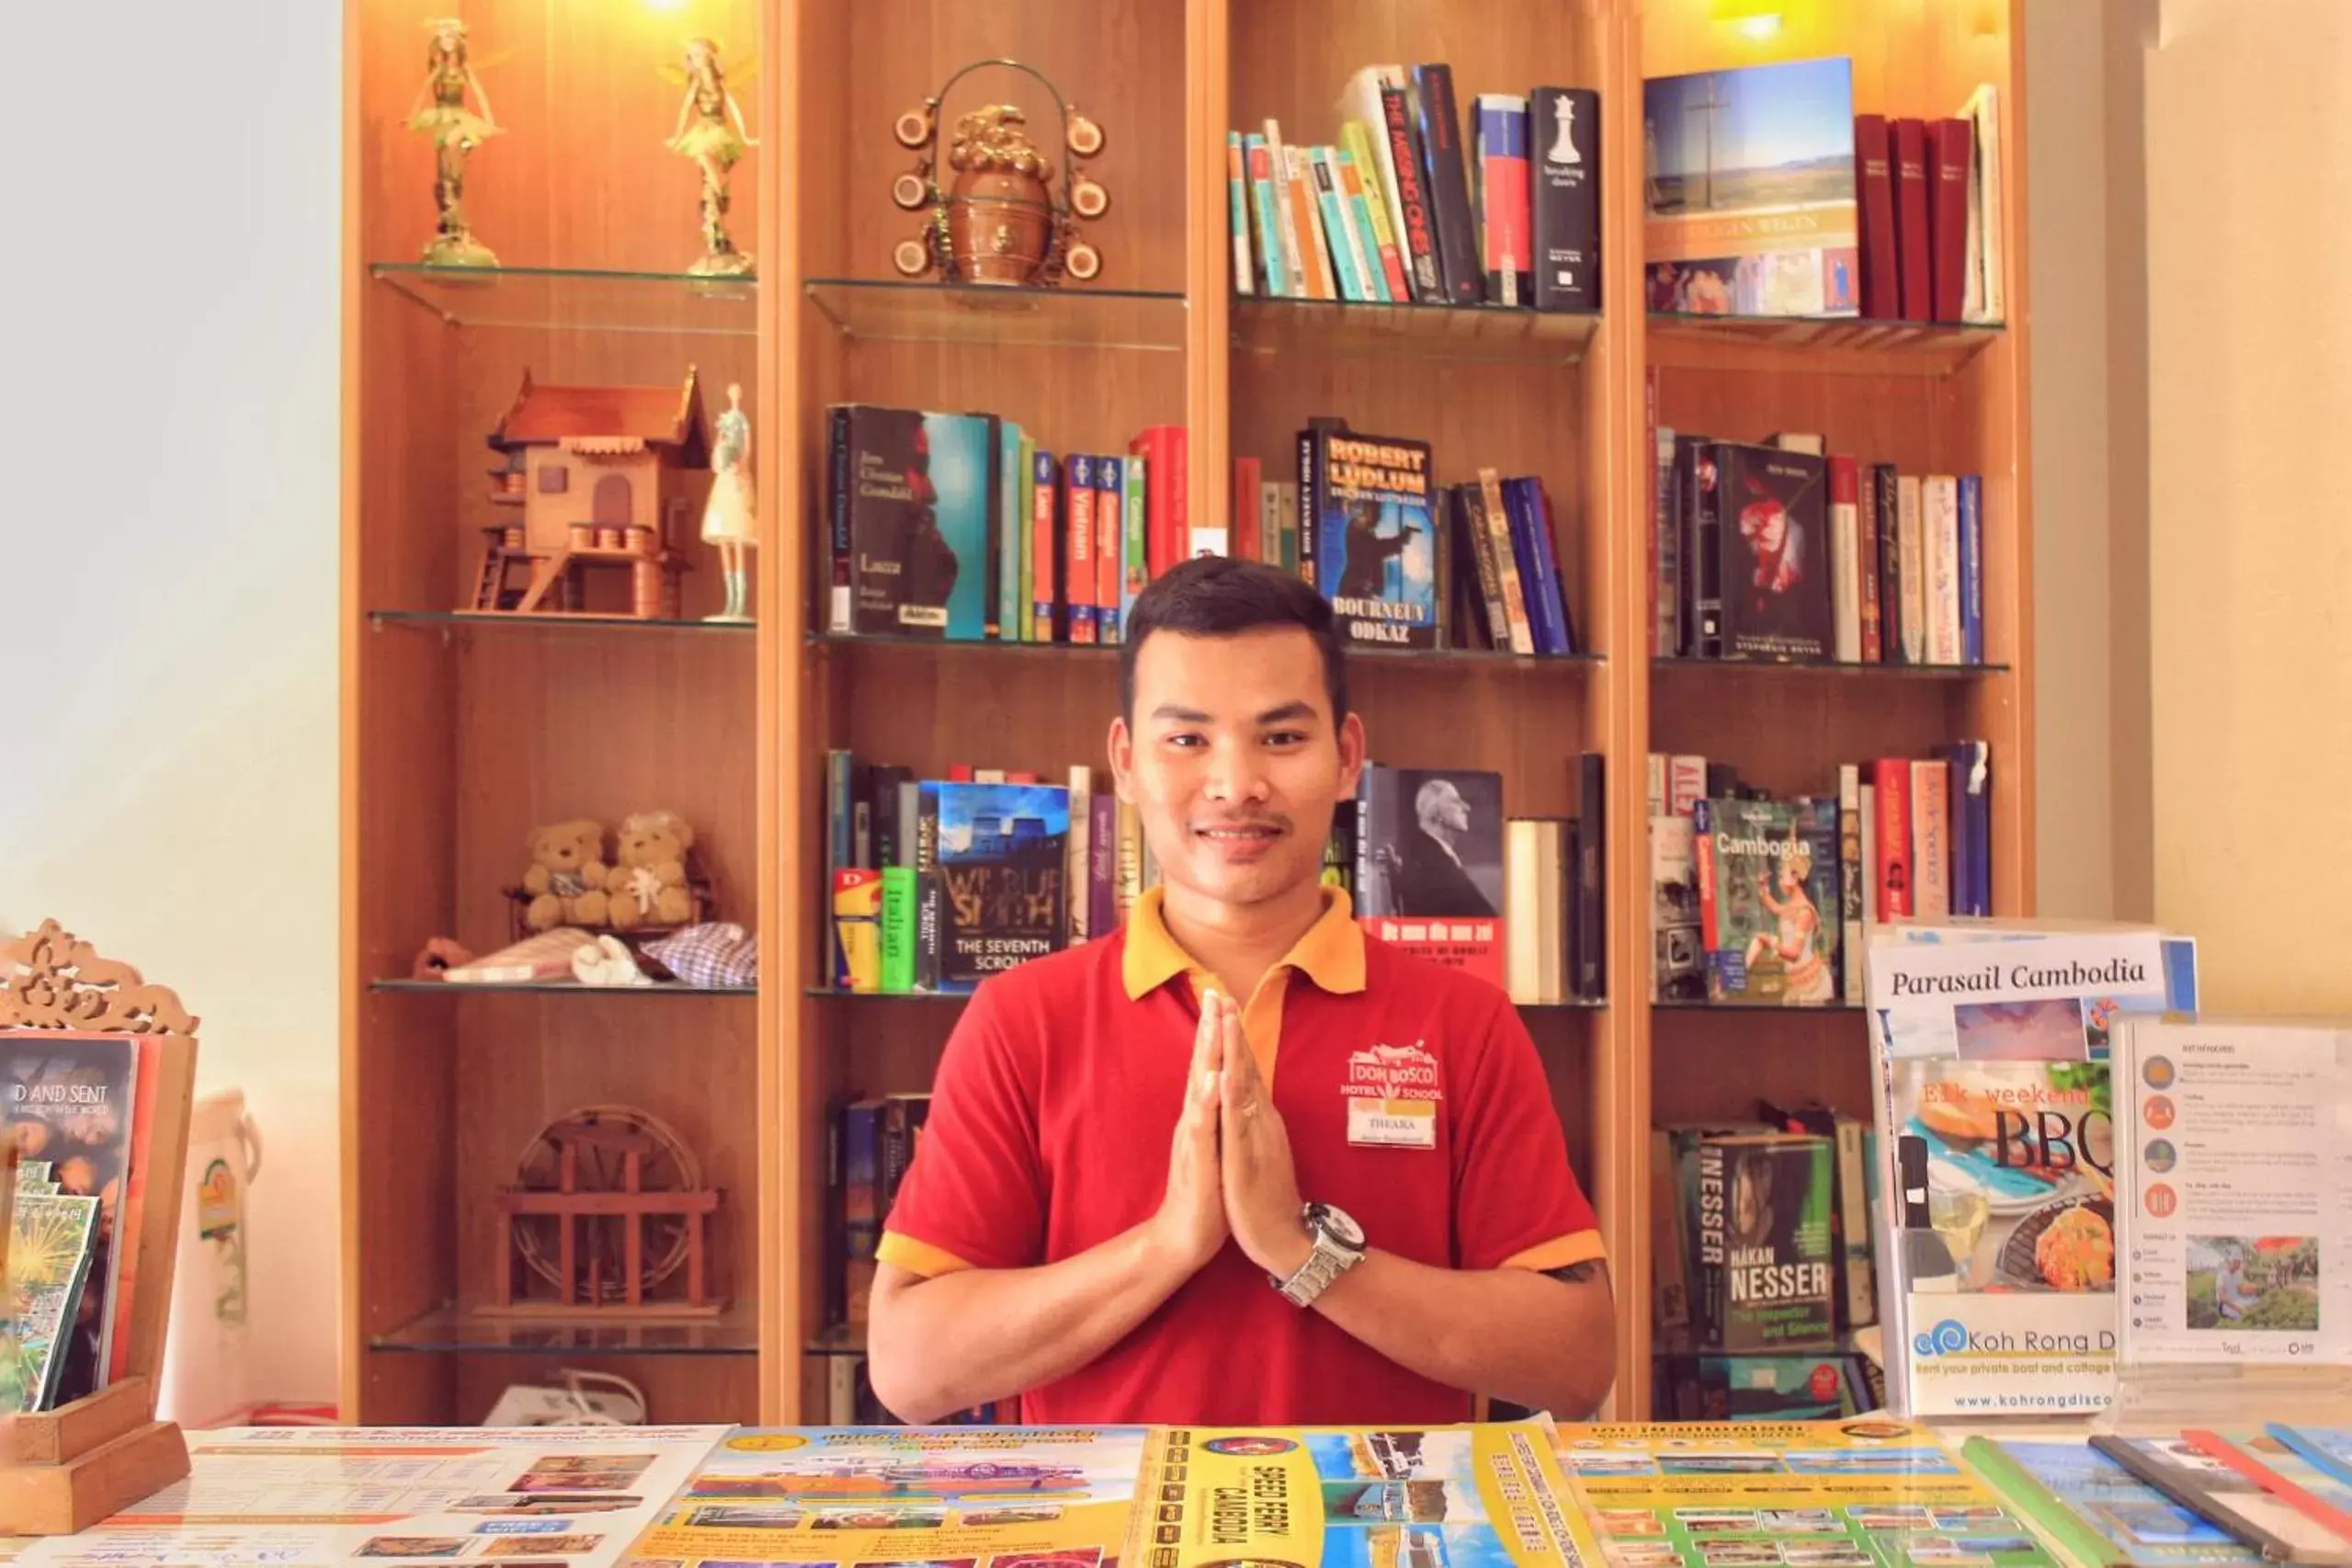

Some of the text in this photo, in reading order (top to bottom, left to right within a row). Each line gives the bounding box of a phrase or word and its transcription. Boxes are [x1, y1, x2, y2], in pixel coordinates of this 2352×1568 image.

[1329, 437, 1426, 470] ROBERT
[1329, 461, 1426, 495] LUDLUM
[1073, 493, 1088, 561] Vietnam
[1718, 832, 1811, 858] Cambogia
[956, 939, 1051, 954] THE SEVENTH
[1892, 959, 2146, 996] Parasail Cambodia
[1356, 1065, 1434, 1085] DON BOSCO
[29, 1085, 65, 1102] AND
[70, 1085, 108, 1103] SENT
[1340, 1085, 1443, 1100] HOTEL SCHOOL
[1984, 1085, 2090, 1105] weekend
[1702, 1158, 1724, 1264] NESSER
[1731, 1262, 1827, 1301] NESSER
[1969, 1331, 2015, 1352] Koh
[2026, 1331, 2089, 1356] Rong
[1915, 1362, 1942, 1374] Rent
[1943, 1364, 1968, 1377] your
[1970, 1361, 2009, 1377] private
[2013, 1362, 2039, 1374] boat
[2041, 1361, 2063, 1374] and
[1211, 1487, 1247, 1544] CAMBODIA
[1254, 1466, 1290, 1536] SPEED FERRY
